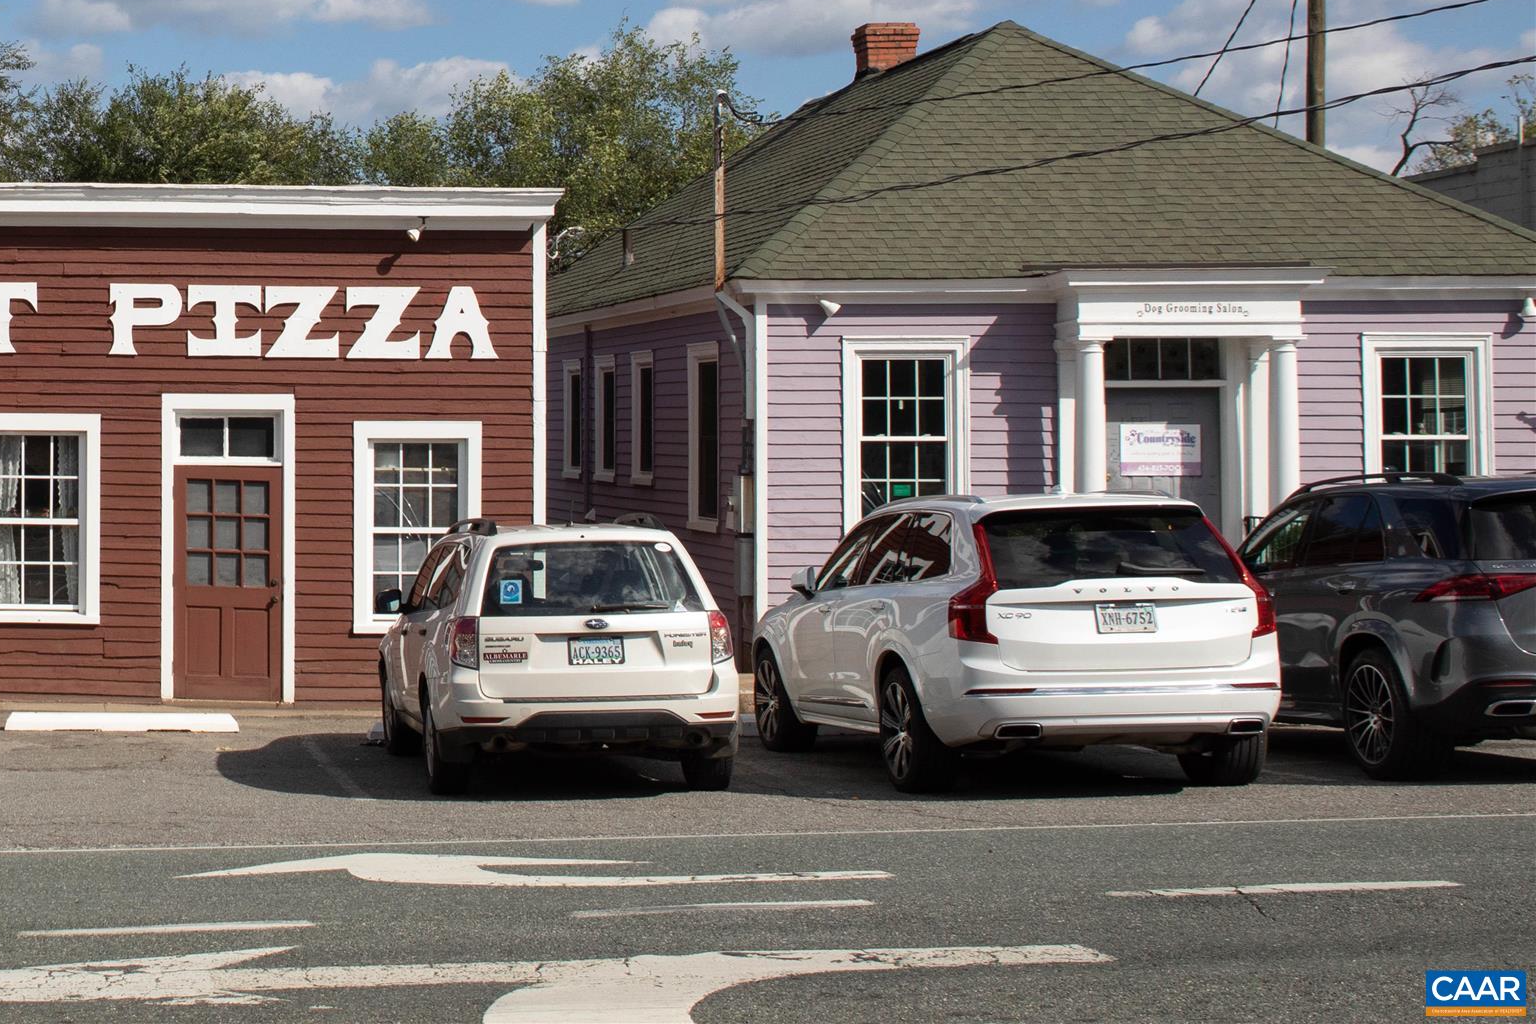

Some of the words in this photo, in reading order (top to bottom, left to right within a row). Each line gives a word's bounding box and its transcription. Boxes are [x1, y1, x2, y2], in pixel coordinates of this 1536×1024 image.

[1144, 303, 1162, 314] Dog
[1166, 303, 1213, 314] Grooming
[1216, 302, 1242, 313] Salon
[108, 283, 499, 360] PIZZA
[1136, 430, 1196, 445] Countryside
[1072, 585, 1180, 594] VOLVO
[1100, 610, 1155, 626] XNH-6752
[573, 646, 621, 659] ACK-9365
